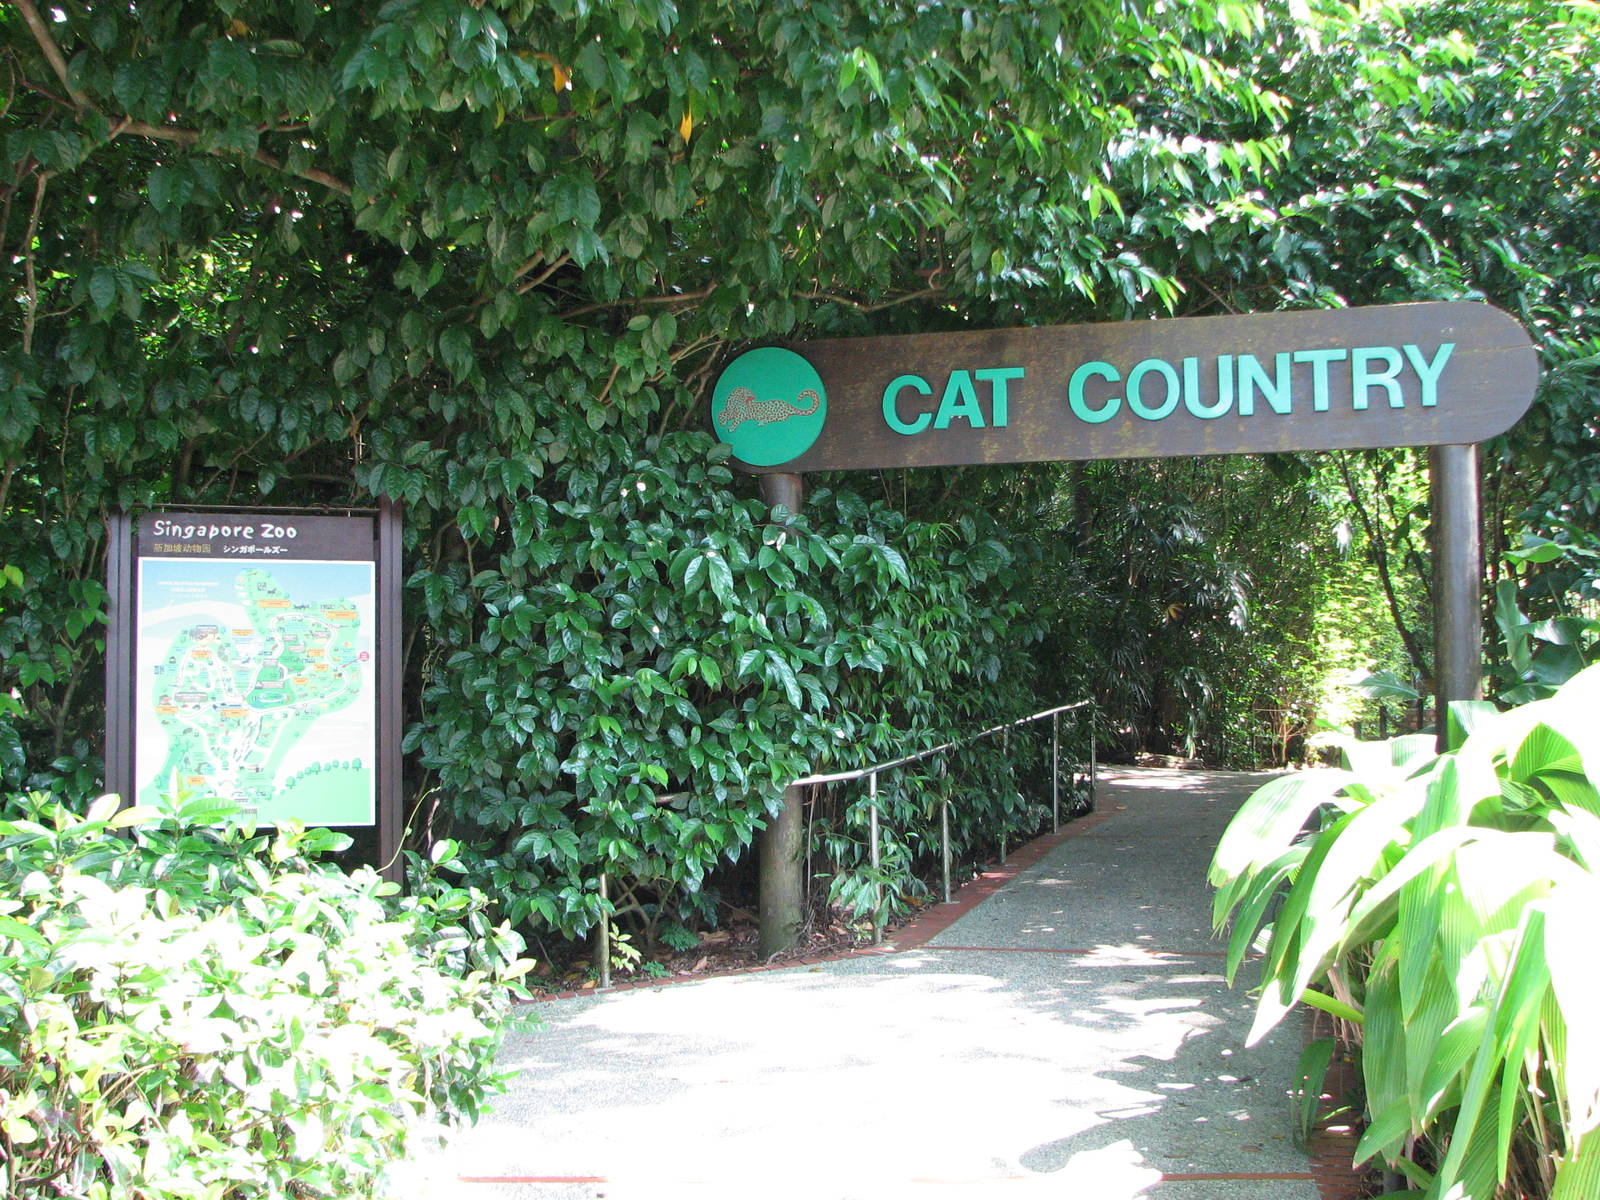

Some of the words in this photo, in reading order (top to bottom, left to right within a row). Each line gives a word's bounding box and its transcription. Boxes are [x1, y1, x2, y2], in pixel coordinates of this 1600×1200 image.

[882, 367, 1024, 435] CAT
[1068, 343, 1456, 424] COUNTRY
[153, 520, 254, 539] Singapore
[261, 524, 297, 538] Zoo
